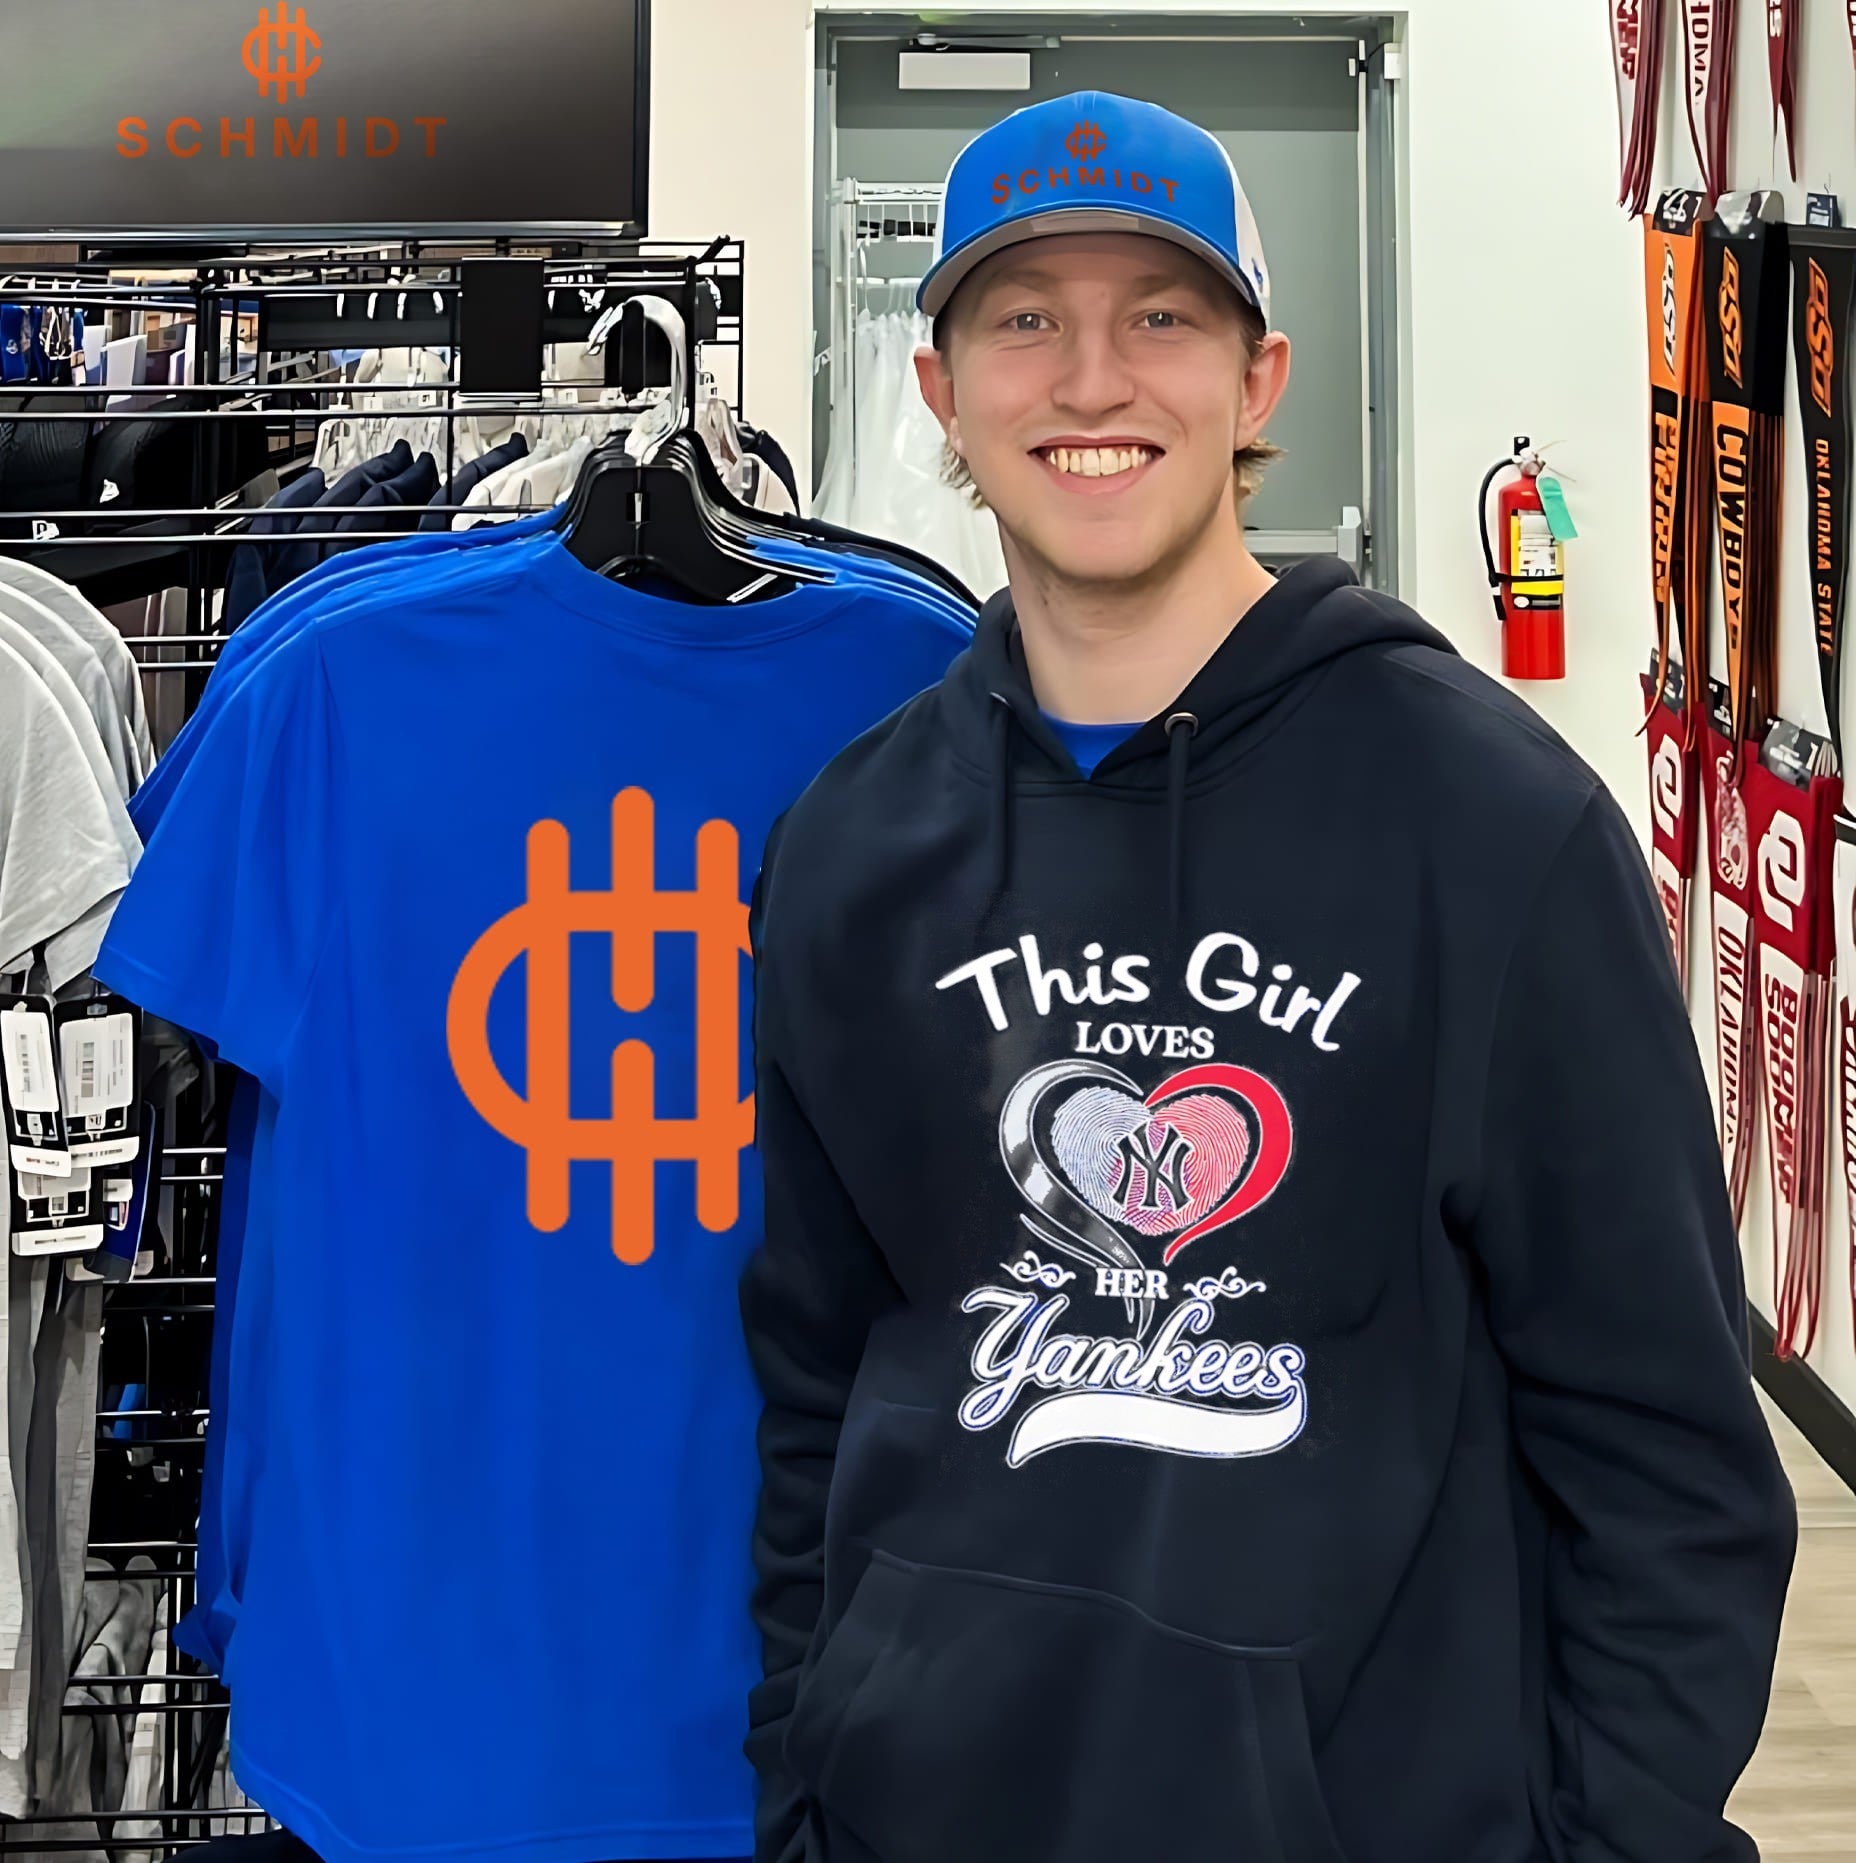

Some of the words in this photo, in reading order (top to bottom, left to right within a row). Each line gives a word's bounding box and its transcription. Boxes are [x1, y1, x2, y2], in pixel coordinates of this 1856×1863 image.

[115, 116, 447, 159] SCHMIDT
[991, 166, 1179, 205] SCHMIDT
[1815, 438, 1832, 571] OKLAHOMA
[935, 934, 1150, 1031] This
[1186, 932, 1362, 1052] Girl
[1075, 1020, 1215, 1059] LOVES
[1717, 926, 1745, 1144] OKLAHOMA
[1094, 1267, 1169, 1300] HER
[958, 1286, 1307, 1431] Yankees
